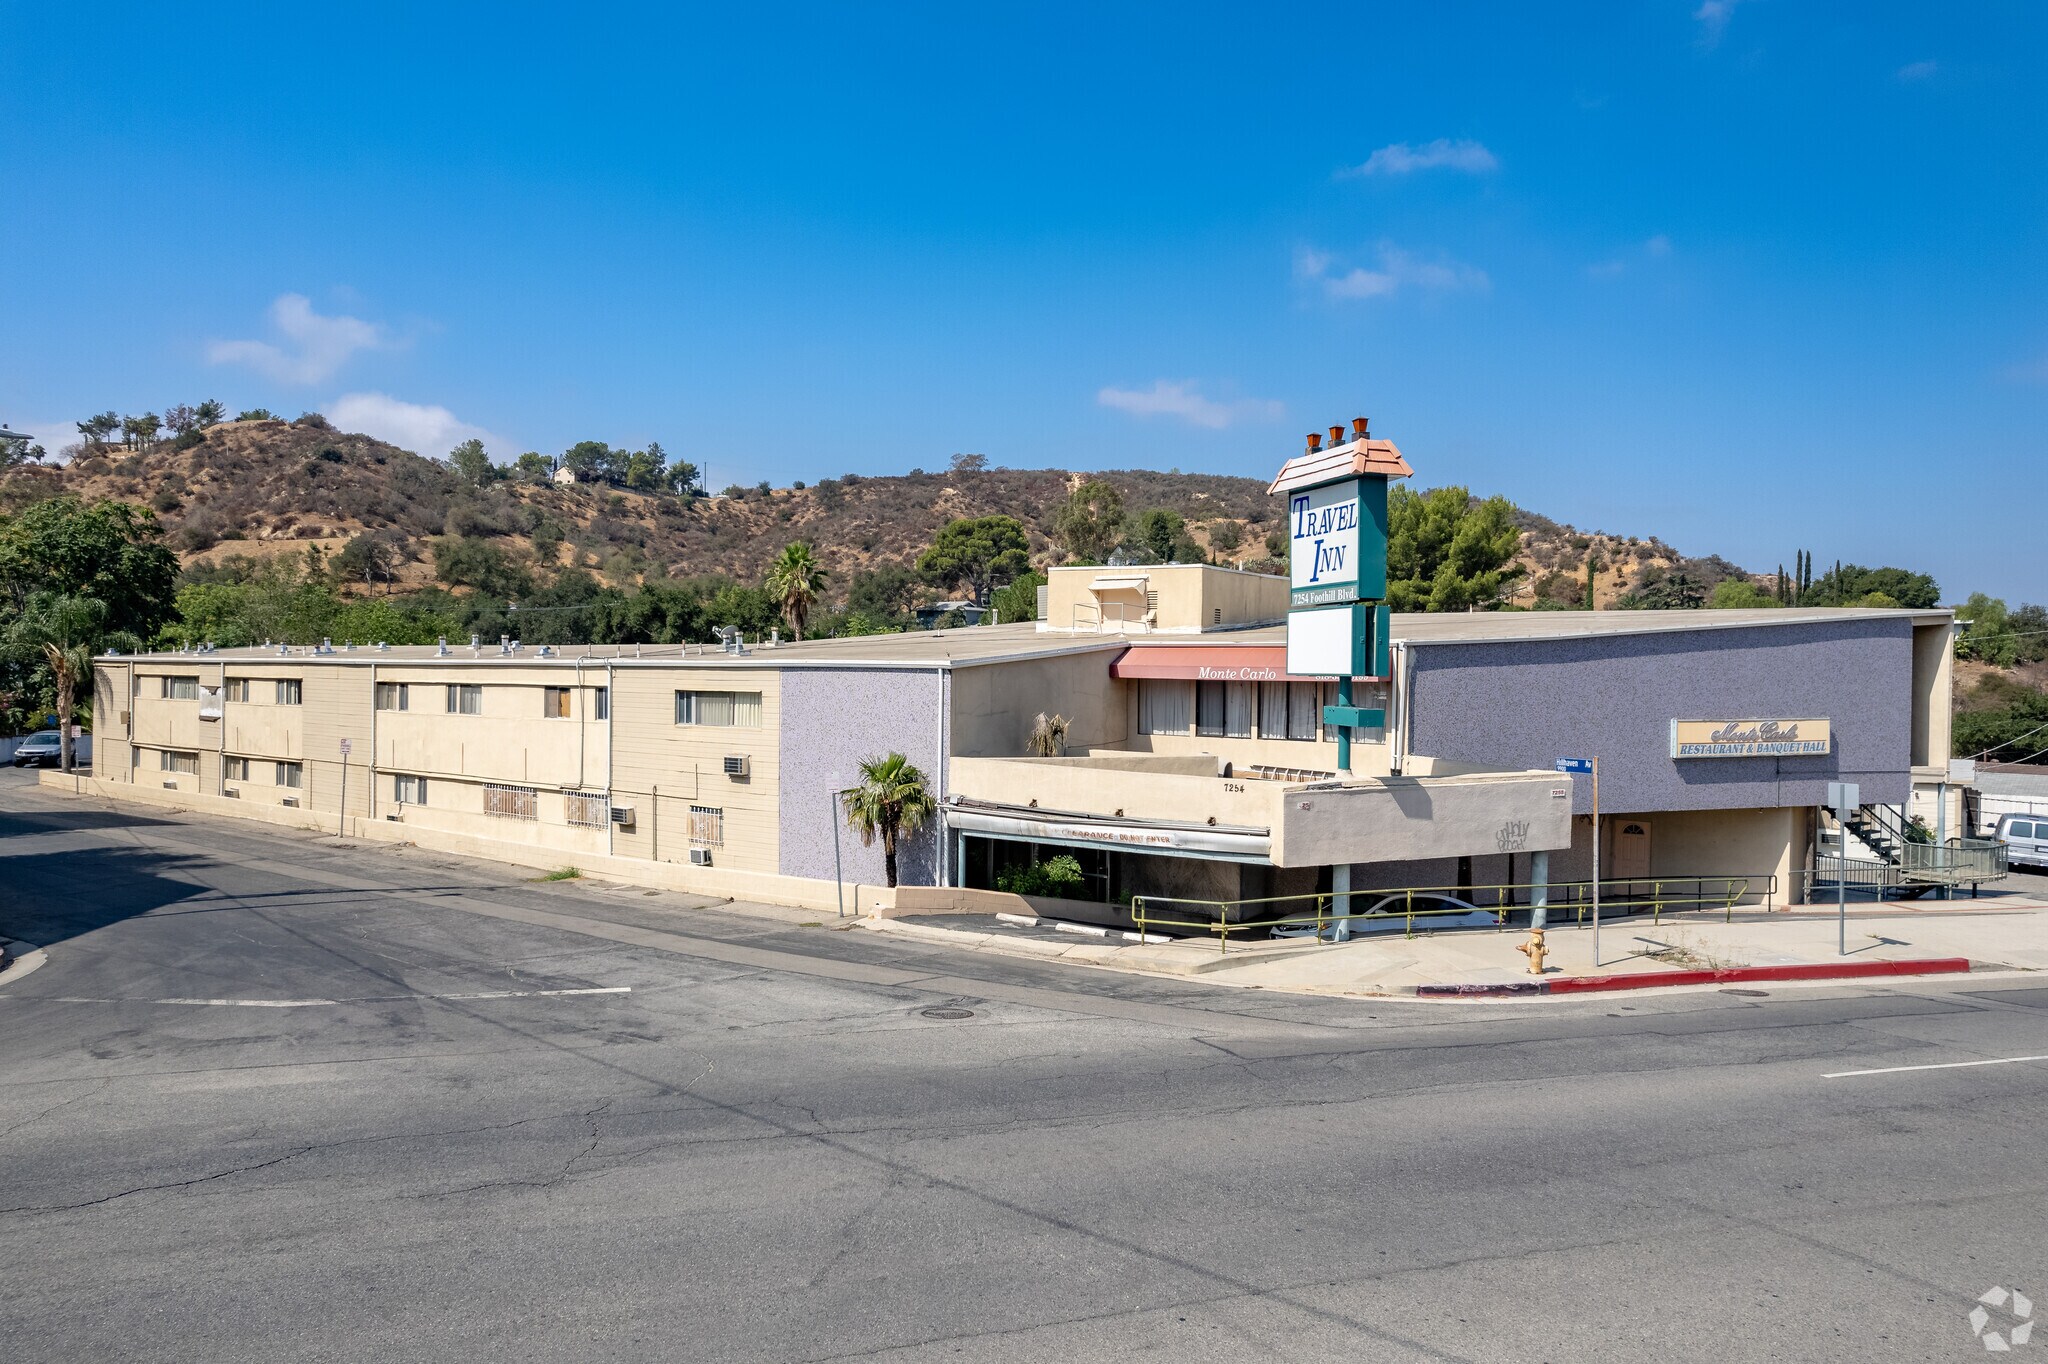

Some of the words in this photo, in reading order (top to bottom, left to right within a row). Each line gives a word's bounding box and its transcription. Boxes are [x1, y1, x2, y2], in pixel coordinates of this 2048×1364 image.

[1293, 495, 1358, 539] TRAVEL
[1309, 539, 1347, 582] INN
[1293, 593, 1309, 604] 7254
[1310, 589, 1336, 603] Foothill
[1337, 588, 1357, 600] Blvd.
[1198, 667, 1236, 680] Monte
[1240, 667, 1277, 680] Carlo
[1680, 744, 1745, 755] RESTAURANT
[1746, 744, 1754, 754] &
[1756, 743, 1802, 754] BANQUET
[1802, 741, 1826, 752] HALL
[1224, 783, 1245, 793] 7254
